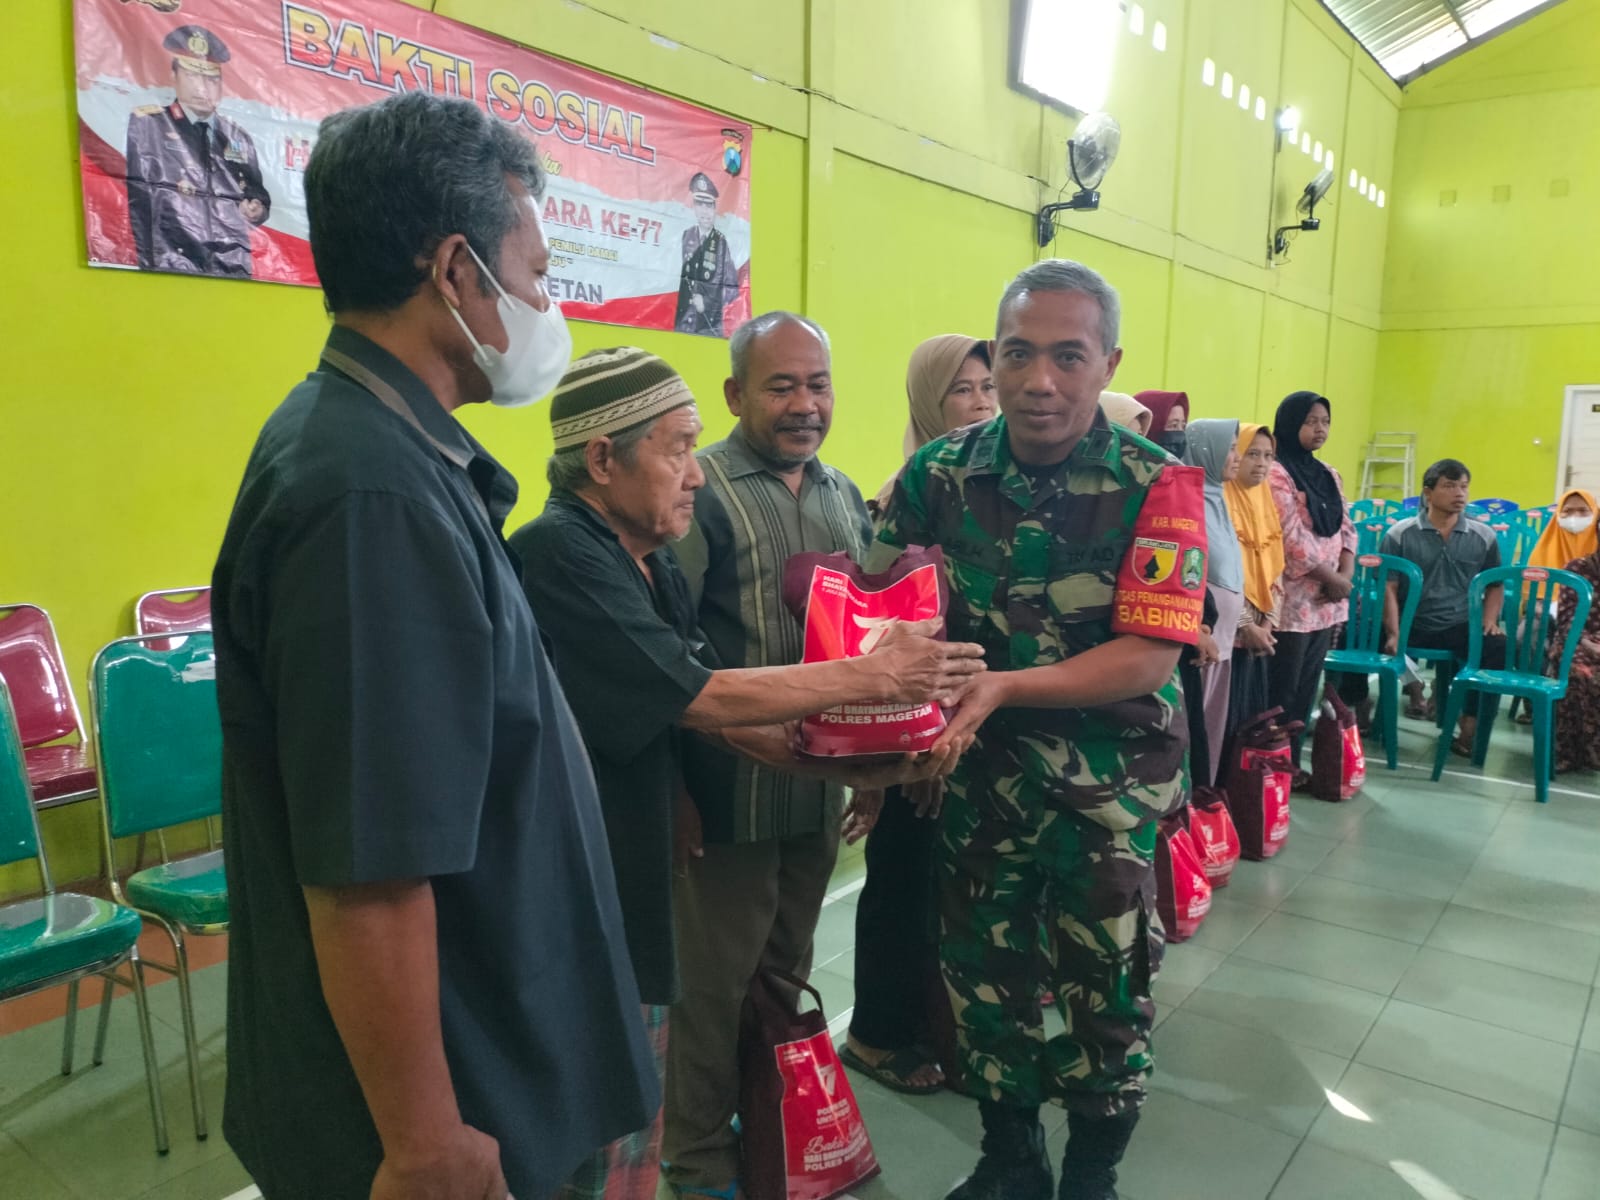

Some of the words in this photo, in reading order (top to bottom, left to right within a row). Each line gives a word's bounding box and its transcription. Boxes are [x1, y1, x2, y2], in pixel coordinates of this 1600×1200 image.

[283, 1, 475, 101] BAKTI
[486, 69, 657, 167] SOSIAL
[542, 195, 595, 233] ARA
[545, 277, 604, 304] ETAN
[1119, 605, 1199, 632] BABINSA
[820, 713, 873, 724] POLRES
[875, 704, 934, 724] MAGETAN
